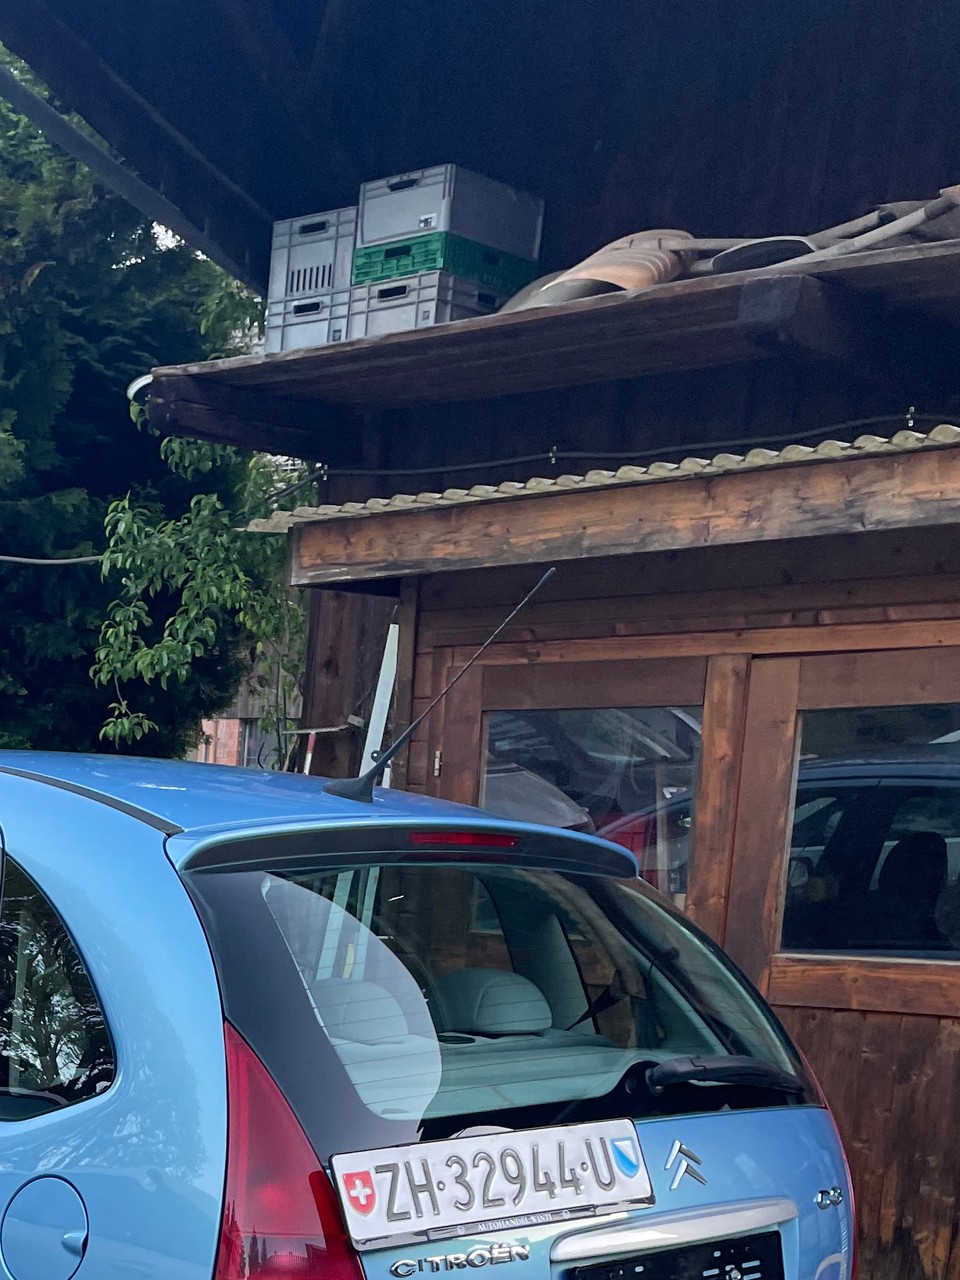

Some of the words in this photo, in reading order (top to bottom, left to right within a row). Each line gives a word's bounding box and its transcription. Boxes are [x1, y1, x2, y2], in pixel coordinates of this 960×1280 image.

[477, 1215, 530, 1232] AUTOHANDEL
[530, 1213, 553, 1224] WINTI
[390, 1243, 529, 1278] CITROËN
